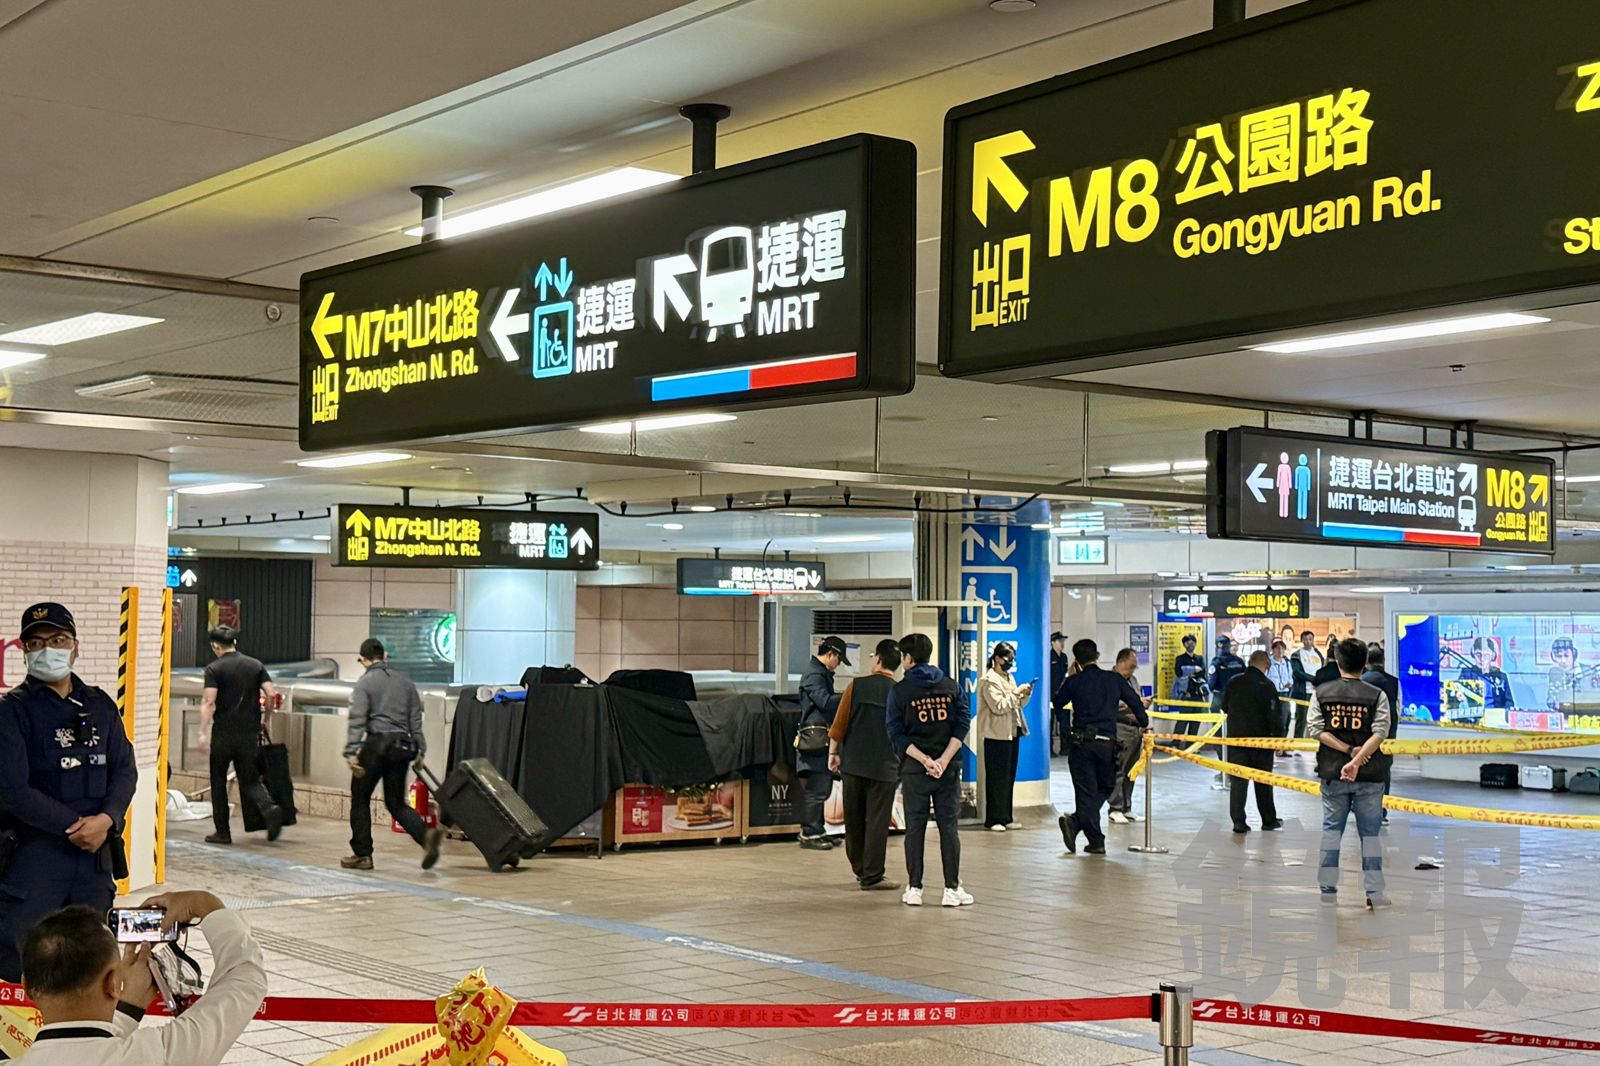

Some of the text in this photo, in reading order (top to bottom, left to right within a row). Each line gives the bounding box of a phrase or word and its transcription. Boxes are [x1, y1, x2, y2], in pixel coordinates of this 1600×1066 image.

[1175, 88, 1375, 206] 公園路
[1049, 159, 1160, 258] M8
[1173, 170, 1441, 260] Gongyuan Rd.
[756, 209, 847, 293] 捷運
[971, 234, 1031, 332] 出口
[576, 278, 636, 337] 捷運
[757, 292, 820, 337] MRT
[1000, 298, 1030, 324] EXIT
[576, 340, 618, 373] MRT
[345, 350, 479, 393] Zhongshan N. Rd.
[312, 363, 339, 424] 出口
[324, 403, 339, 422] EXIT
[1329, 455, 1455, 497] 捷運台北車站
[1486, 467, 1526, 510] M8
[1328, 491, 1455, 518] MRT Taipei Main Station
[1495, 511, 1527, 530] 公園路
[375, 541, 481, 558] Zhongshan N. Rd.
[519, 544, 546, 558] MRT
[1267, 594, 1289, 612] M8
[918, 709, 948, 723] CID
[1331, 716, 1362, 730] CID
[771, 784, 789, 800] NY
[596, 1008, 689, 1022] 台北捷運公司
[866, 1007, 956, 1022] 台北捷運公司
[1226, 1005, 1320, 1026] 台北捷運公司
